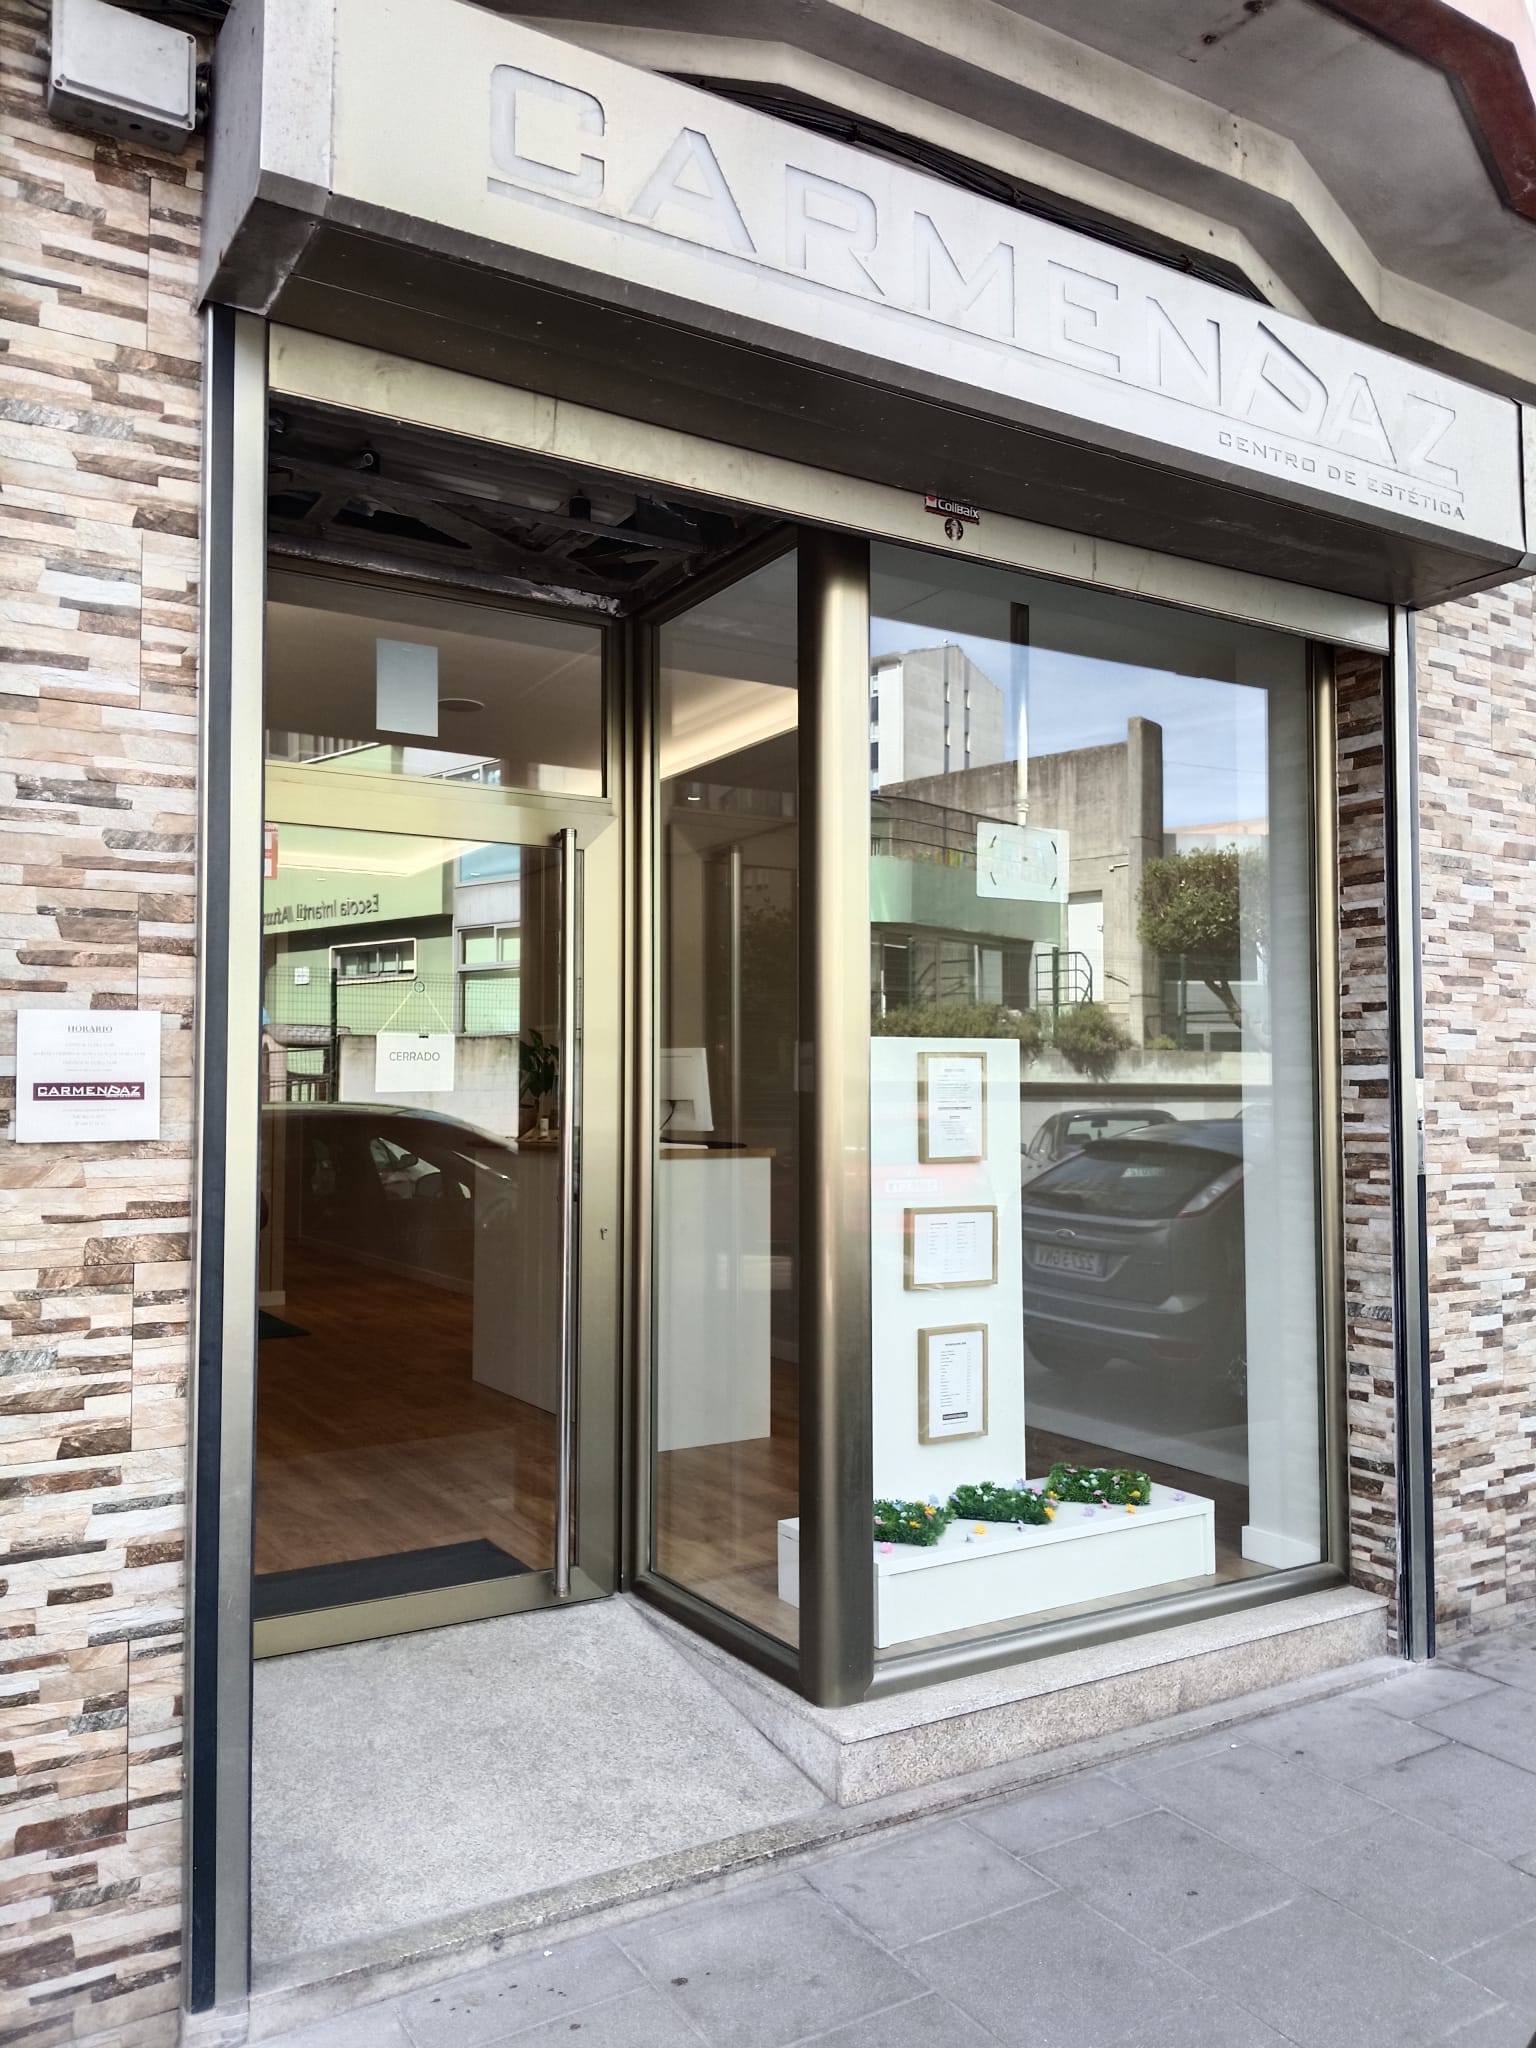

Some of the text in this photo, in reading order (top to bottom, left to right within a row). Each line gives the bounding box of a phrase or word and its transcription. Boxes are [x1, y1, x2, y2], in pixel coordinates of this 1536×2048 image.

[1218, 431, 1466, 521] CENTRO DE ESTÉTICA
[67, 1025, 113, 1033] HORARIO
[388, 1051, 441, 1062] CERRADO
